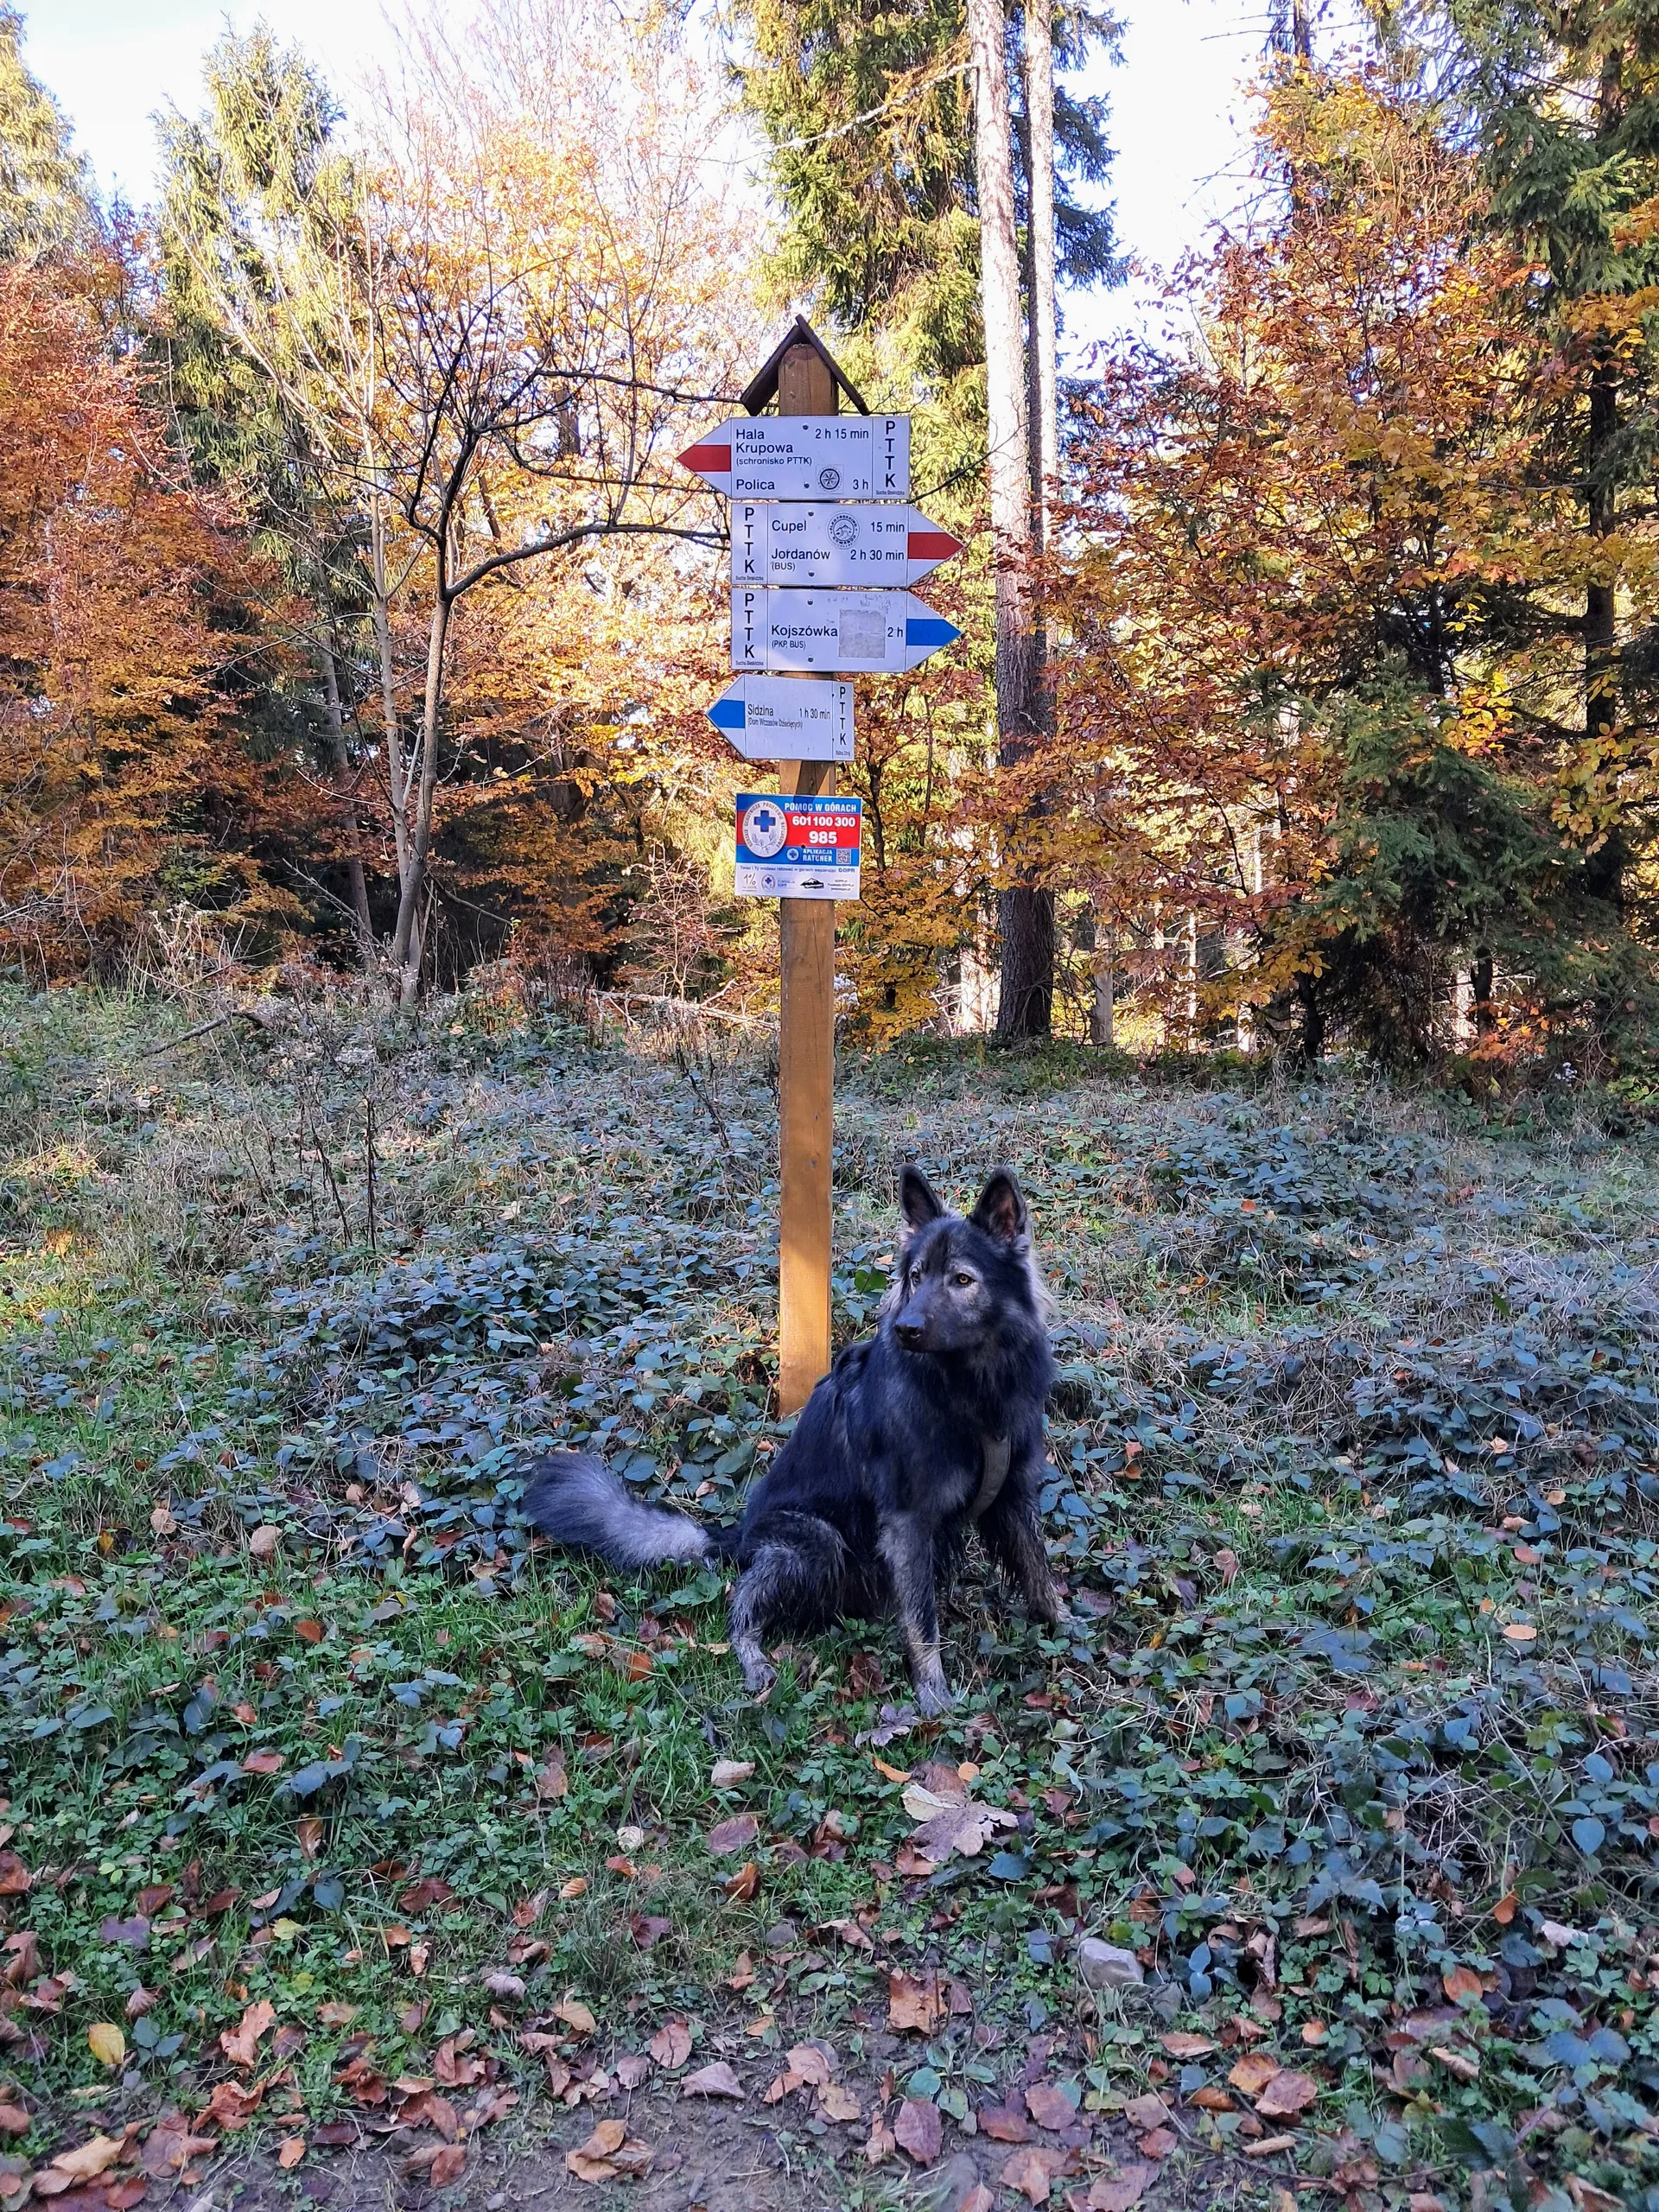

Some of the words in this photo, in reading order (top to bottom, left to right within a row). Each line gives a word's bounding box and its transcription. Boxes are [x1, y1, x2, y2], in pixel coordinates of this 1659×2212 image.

[735, 429, 765, 440] Hala
[815, 429, 822, 440] 2
[825, 428, 831, 439] h
[835, 429, 847, 439] 15
[850, 428, 869, 439] min
[735, 442, 793, 455] Krupowa
[736, 457, 785, 466] (schronisko
[786, 456, 812, 466] PTTK)
[736, 479, 775, 490] Polica
[852, 480, 859, 490] 3
[862, 480, 869, 490] h
[772, 520, 807, 534] Cupel
[870, 522, 882, 532] 15
[886, 522, 905, 533] min
[771, 548, 830, 560] Jordanów
[850, 550, 857, 560] 2
[860, 550, 867, 560] h
[869, 550, 882, 561] 30
[885, 550, 905, 561] min
[771, 562, 796, 571] (BUS)
[771, 625, 838, 639] Kojszówka
[887, 627, 894, 638] 2
[897, 627, 904, 638] h
[789, 640, 806, 650] BUS)
[747, 703, 774, 716] Sidzina
[799, 708, 803, 717] 1
[804, 709, 809, 718] h
[810, 708, 818, 719] 30
[819, 709, 830, 720] min
[784, 802, 813, 811] POMOC
[824, 802, 856, 812] GÓRACH
[792, 816, 811, 826] 601
[813, 817, 833, 826] 100
[835, 817, 855, 827] 300
[809, 830, 837, 844] 985
